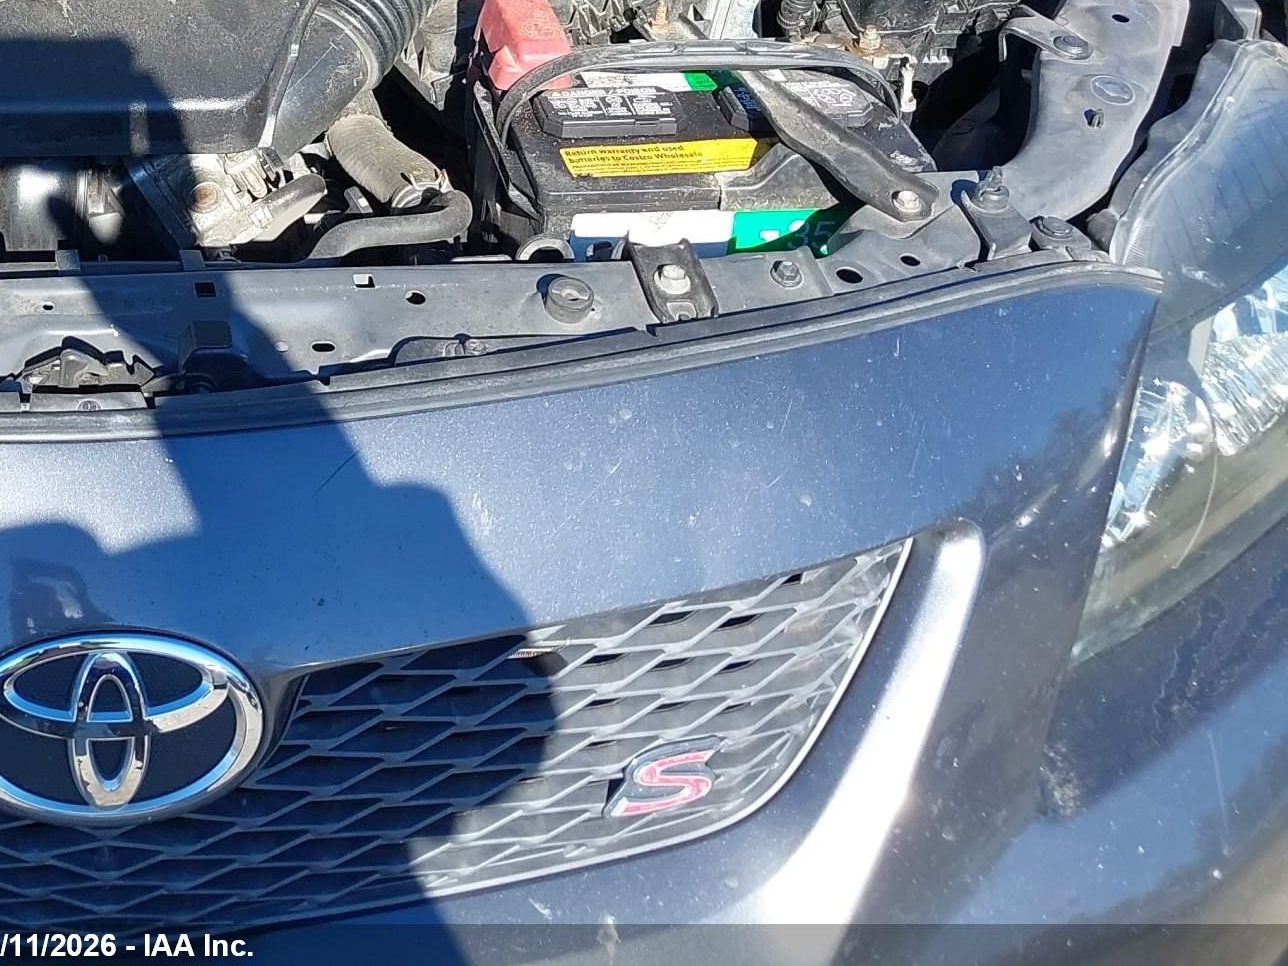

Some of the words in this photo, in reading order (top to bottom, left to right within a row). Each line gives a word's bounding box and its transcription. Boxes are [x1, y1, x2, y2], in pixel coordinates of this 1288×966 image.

[564, 149, 597, 157] Return
[599, 147, 640, 155] warranty
[568, 156, 610, 164] batteries
[623, 153, 653, 161] Costco
